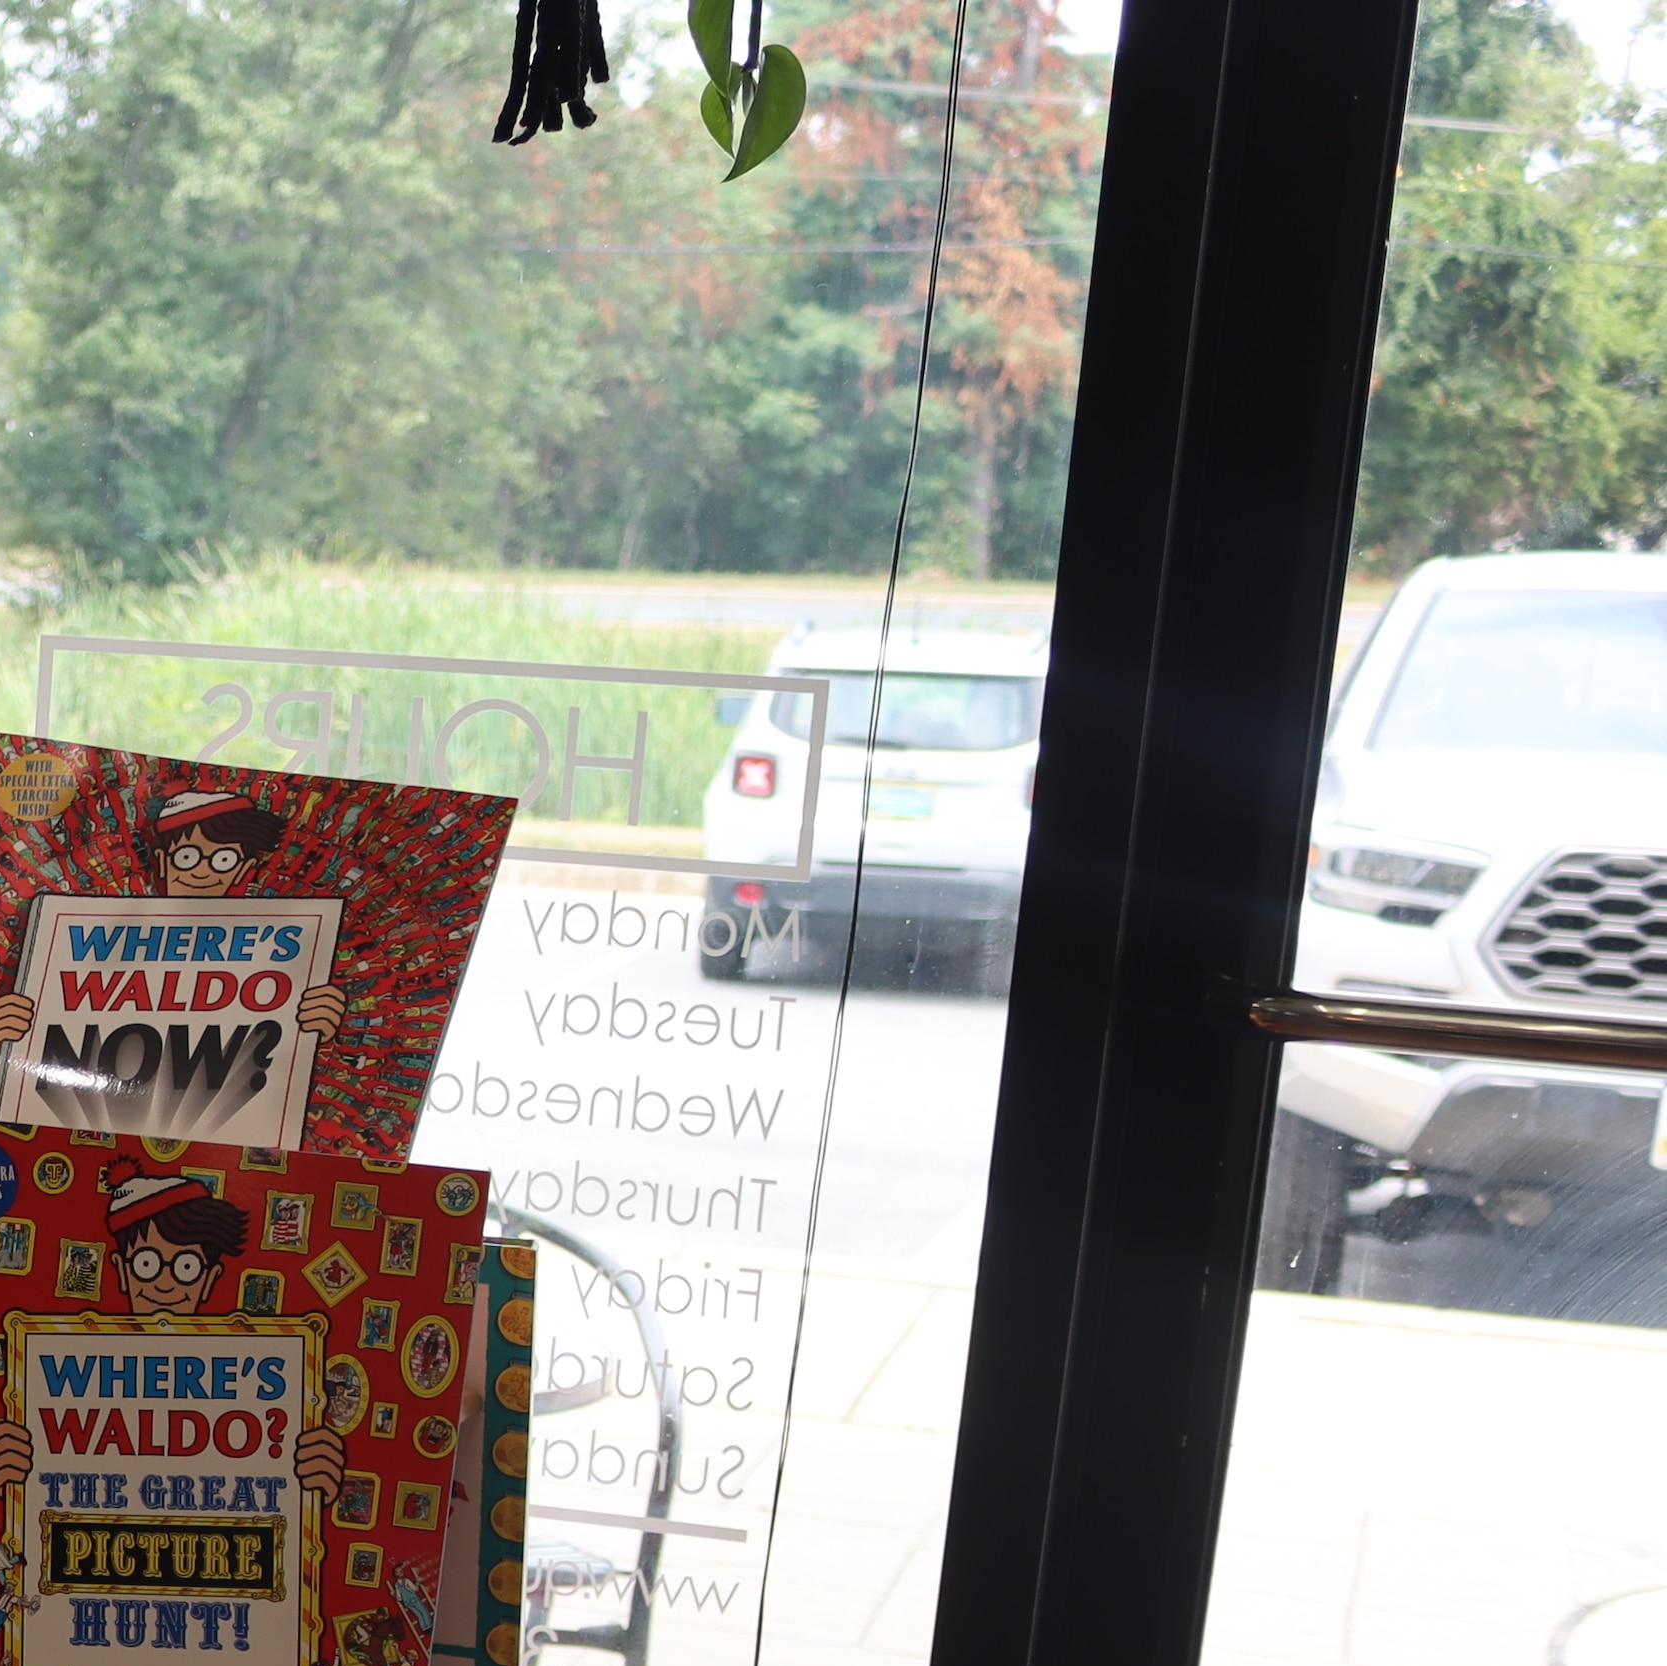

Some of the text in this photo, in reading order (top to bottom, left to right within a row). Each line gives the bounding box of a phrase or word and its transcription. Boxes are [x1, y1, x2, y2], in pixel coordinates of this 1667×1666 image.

[67, 925, 303, 962] WHERE'S
[58, 970, 292, 1012] WALDO
[36, 1019, 284, 1108] NOW?
[39, 1354, 287, 1401] WHERE'S
[39, 1406, 287, 1461] WALDO?
[39, 1471, 286, 1514] THE GREAT
[63, 1530, 264, 1579] PICTURE
[69, 1598, 250, 1651] HUNT!
